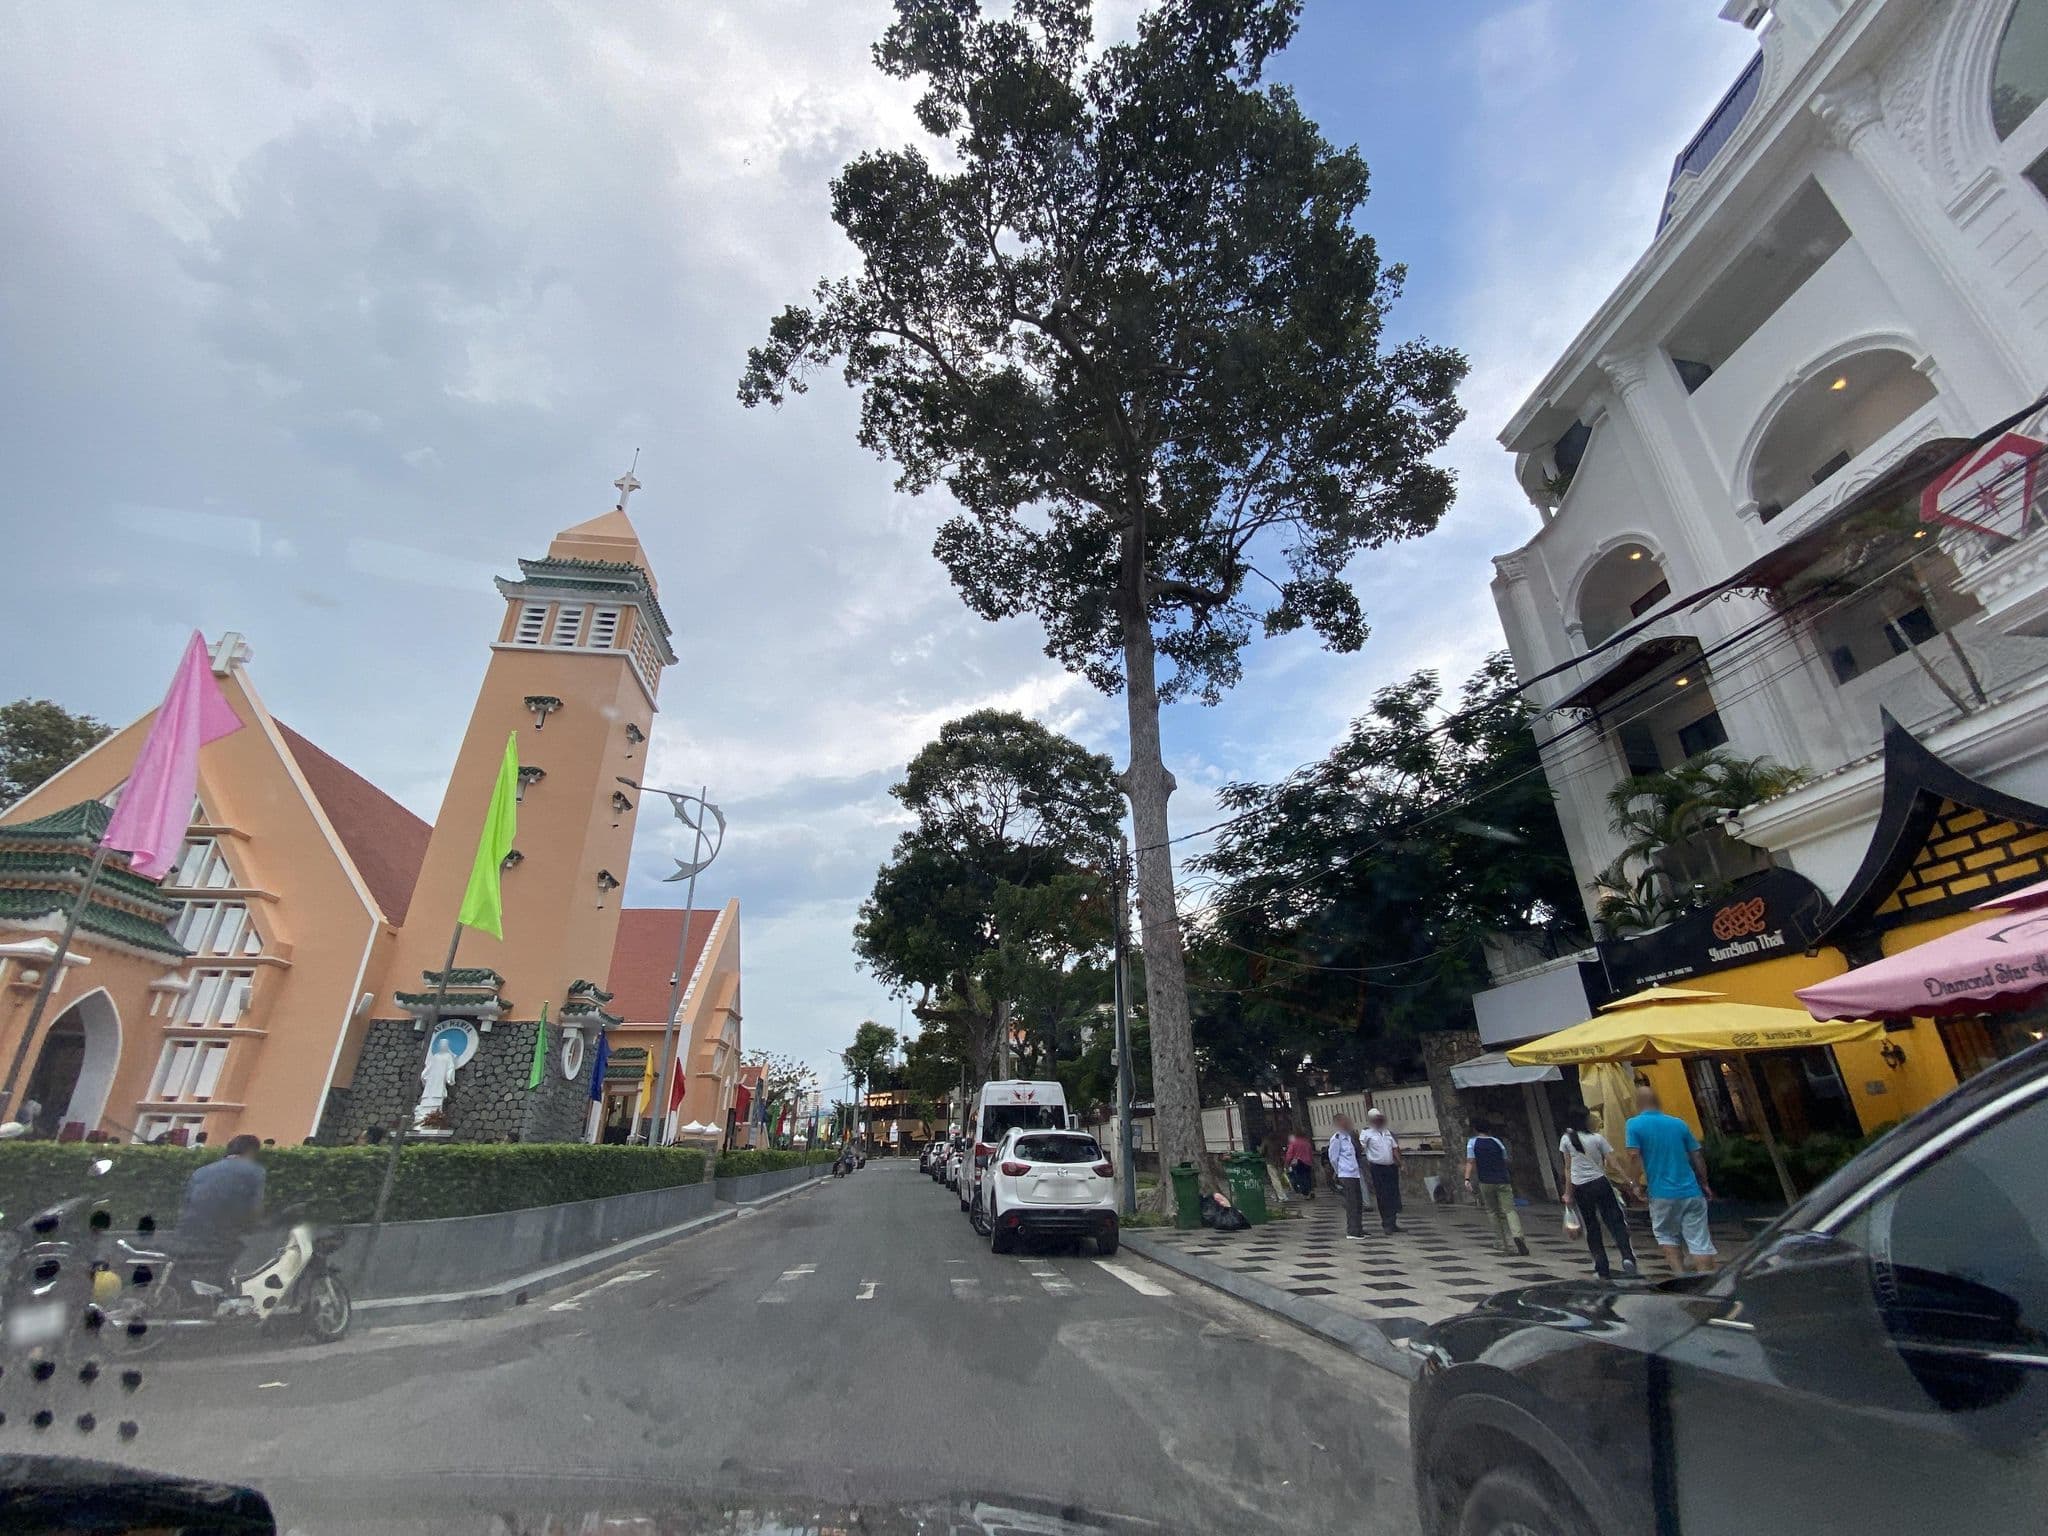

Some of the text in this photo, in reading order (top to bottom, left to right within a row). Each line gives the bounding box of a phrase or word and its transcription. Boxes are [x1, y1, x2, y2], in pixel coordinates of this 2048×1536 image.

[1923, 967, 1994, 997] Diamond
[1994, 963, 2030, 984] Star
[450, 1020, 473, 1034] MARIA
